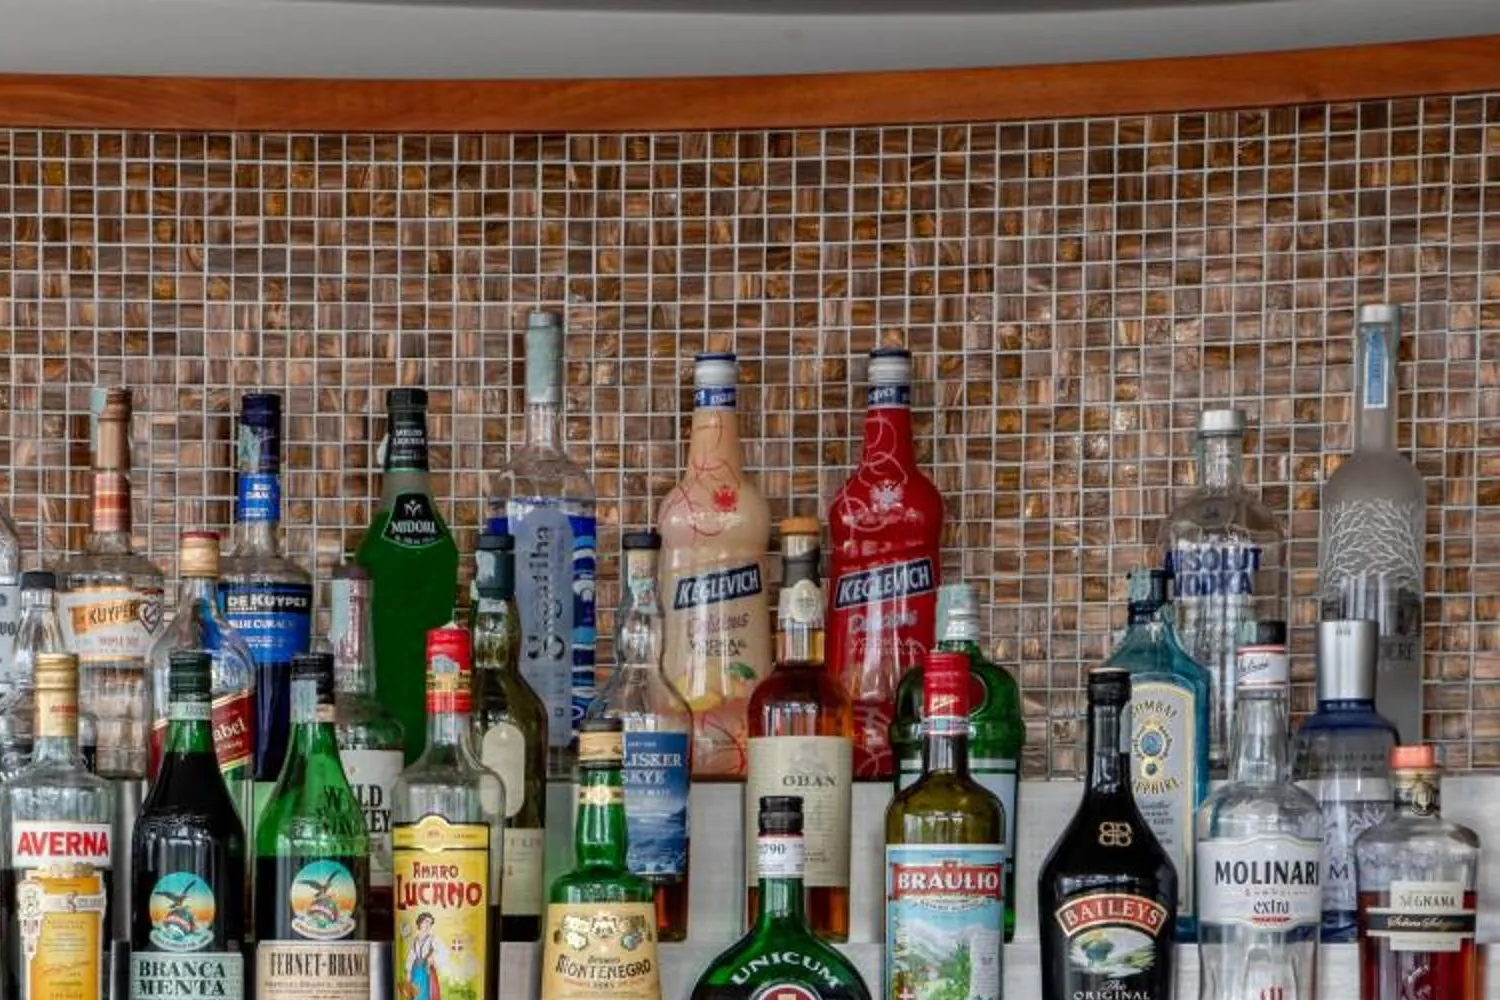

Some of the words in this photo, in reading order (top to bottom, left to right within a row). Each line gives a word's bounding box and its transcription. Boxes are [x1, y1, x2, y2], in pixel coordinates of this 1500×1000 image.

[391, 520, 436, 533] MIDORI
[677, 568, 760, 605] KEGLEVICH
[227, 595, 248, 606] DE
[1133, 699, 1178, 718] OMBAY
[213, 717, 247, 742] abel
[623, 753, 683, 767] LISKER
[782, 775, 838, 787] OBAN
[17, 831, 110, 857] AVERNA
[412, 861, 460, 881] AMARO
[898, 871, 1000, 890] BRAULIO
[1214, 860, 1320, 887] MOLINARI
[396, 874, 483, 910] LUCANO
[1063, 900, 1160, 928] BAILEYS
[1253, 898, 1289, 915] extra
[139, 960, 227, 979] BRANCA
[555, 954, 652, 981] MONTENEGRO
[730, 950, 846, 989] UNICUM
[137, 978, 226, 997] MENTA
[1073, 991, 1150, 1000] ORIGINAL
